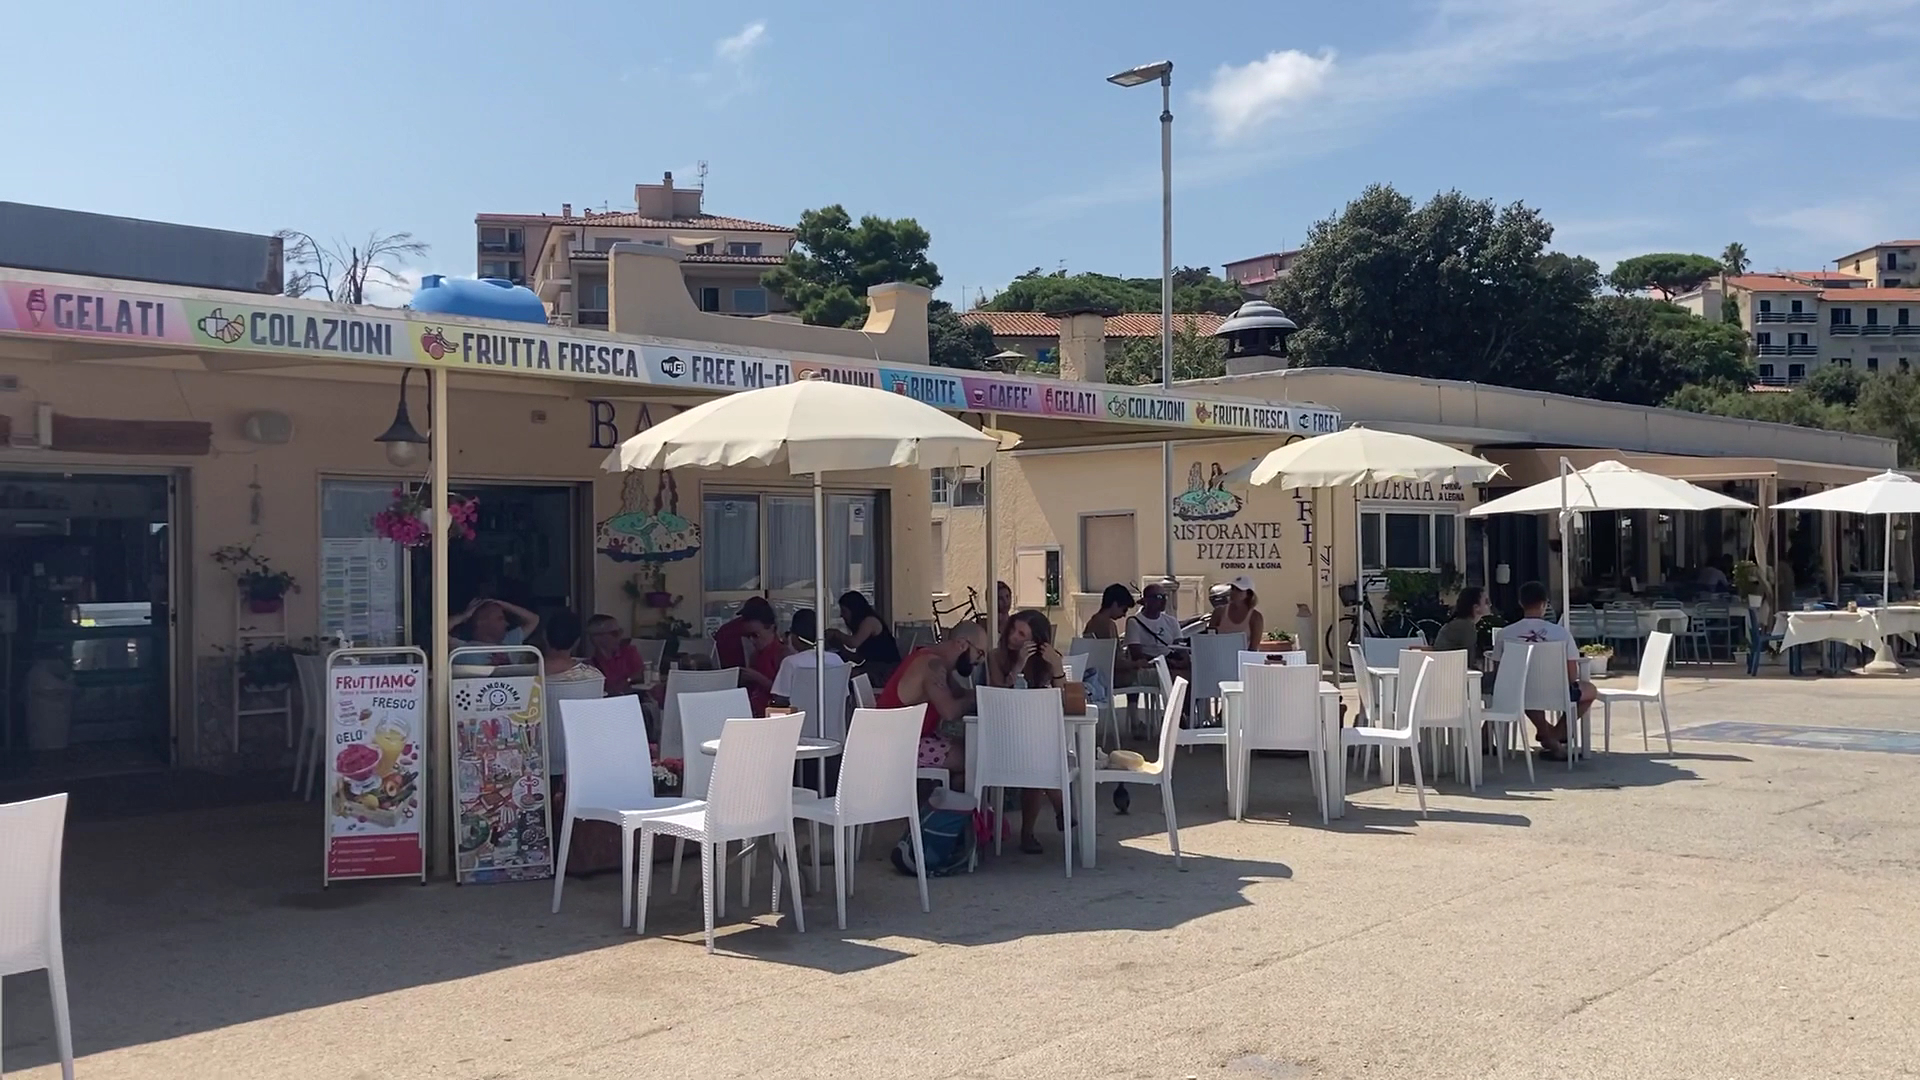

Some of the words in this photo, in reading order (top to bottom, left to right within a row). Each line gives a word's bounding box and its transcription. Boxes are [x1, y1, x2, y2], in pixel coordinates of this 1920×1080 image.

[54, 293, 164, 337] GELATI
[251, 311, 392, 355] COLAZIONI
[463, 332, 550, 370] FRUTTA
[559, 342, 639, 378] FRESCA
[692, 356, 735, 386] FREE
[741, 361, 789, 388] WI-FI
[911, 377, 956, 403] BIBITE
[1055, 390, 1096, 415] GELATI
[1128, 397, 1184, 422] COLAZIONI
[1213, 405, 1250, 427] FRUTTA
[1253, 409, 1289, 429] FRESCA
[1313, 413, 1333, 432] FREE
[1445, 493, 1465, 501] LEGNA
[1173, 522, 1282, 540] RISTORANTE
[1197, 543, 1282, 559] PIZZERIA
[373, 697, 416, 710] FRESCO
[475, 682, 520, 703] SAMMONTANA
[336, 730, 362, 744] GELO
